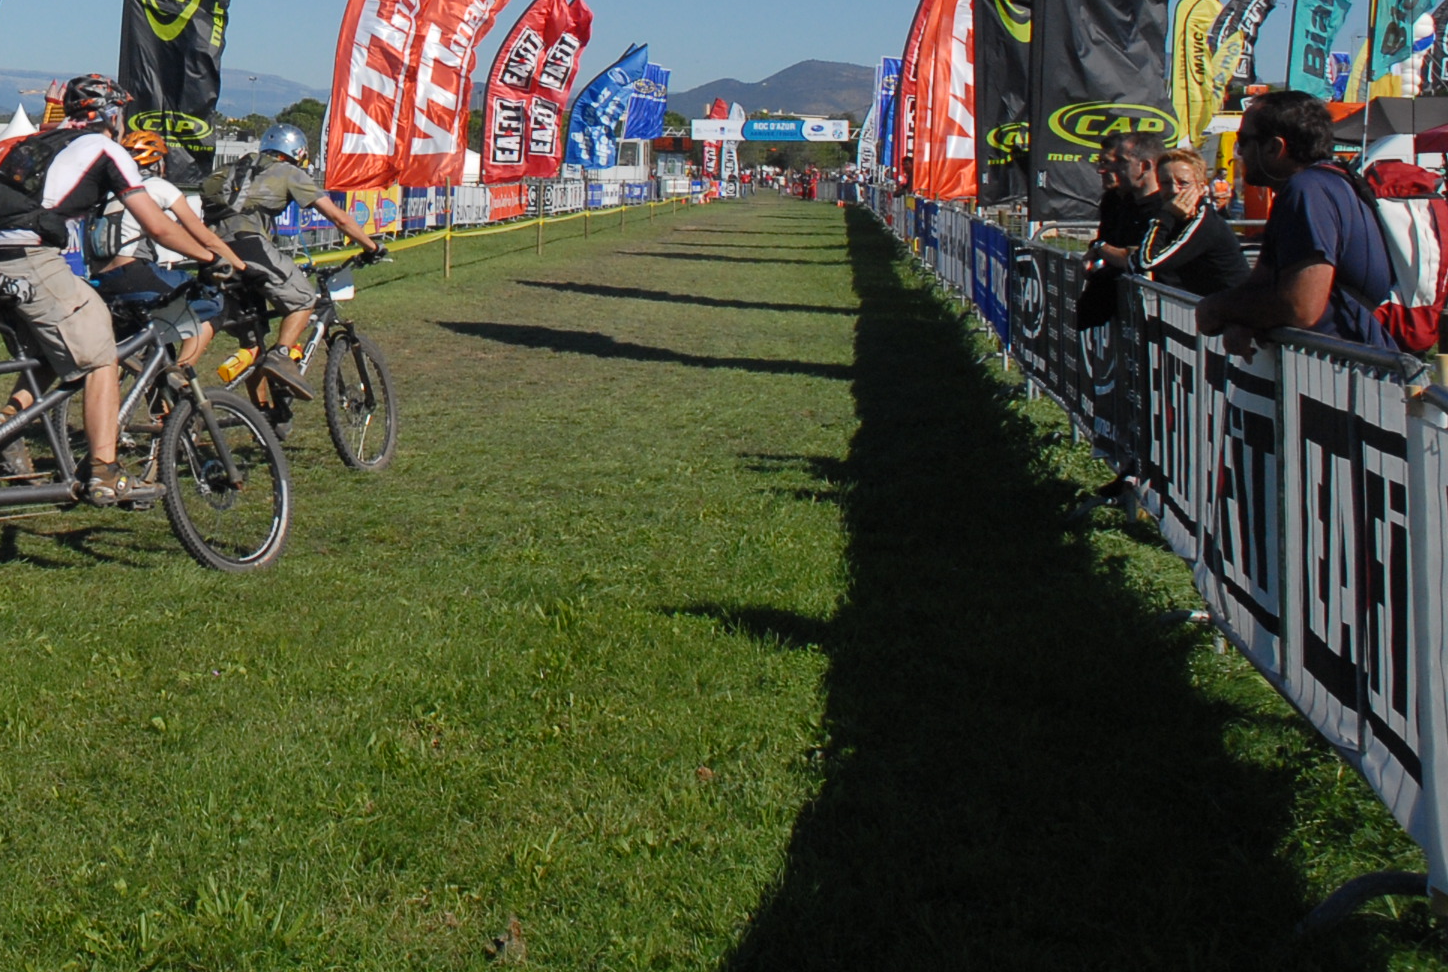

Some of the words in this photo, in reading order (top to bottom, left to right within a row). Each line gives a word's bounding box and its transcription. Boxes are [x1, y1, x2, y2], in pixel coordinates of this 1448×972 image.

[210, 2, 224, 47] mer
[1193, 31, 1205, 75] MAVIC
[411, 22, 463, 155] VTT
[1075, 115, 1164, 135] CAP
[1047, 153, 1082, 162] mer
[1333, 144, 1362, 152] Bian
[1306, 439, 1409, 721] EAFi
